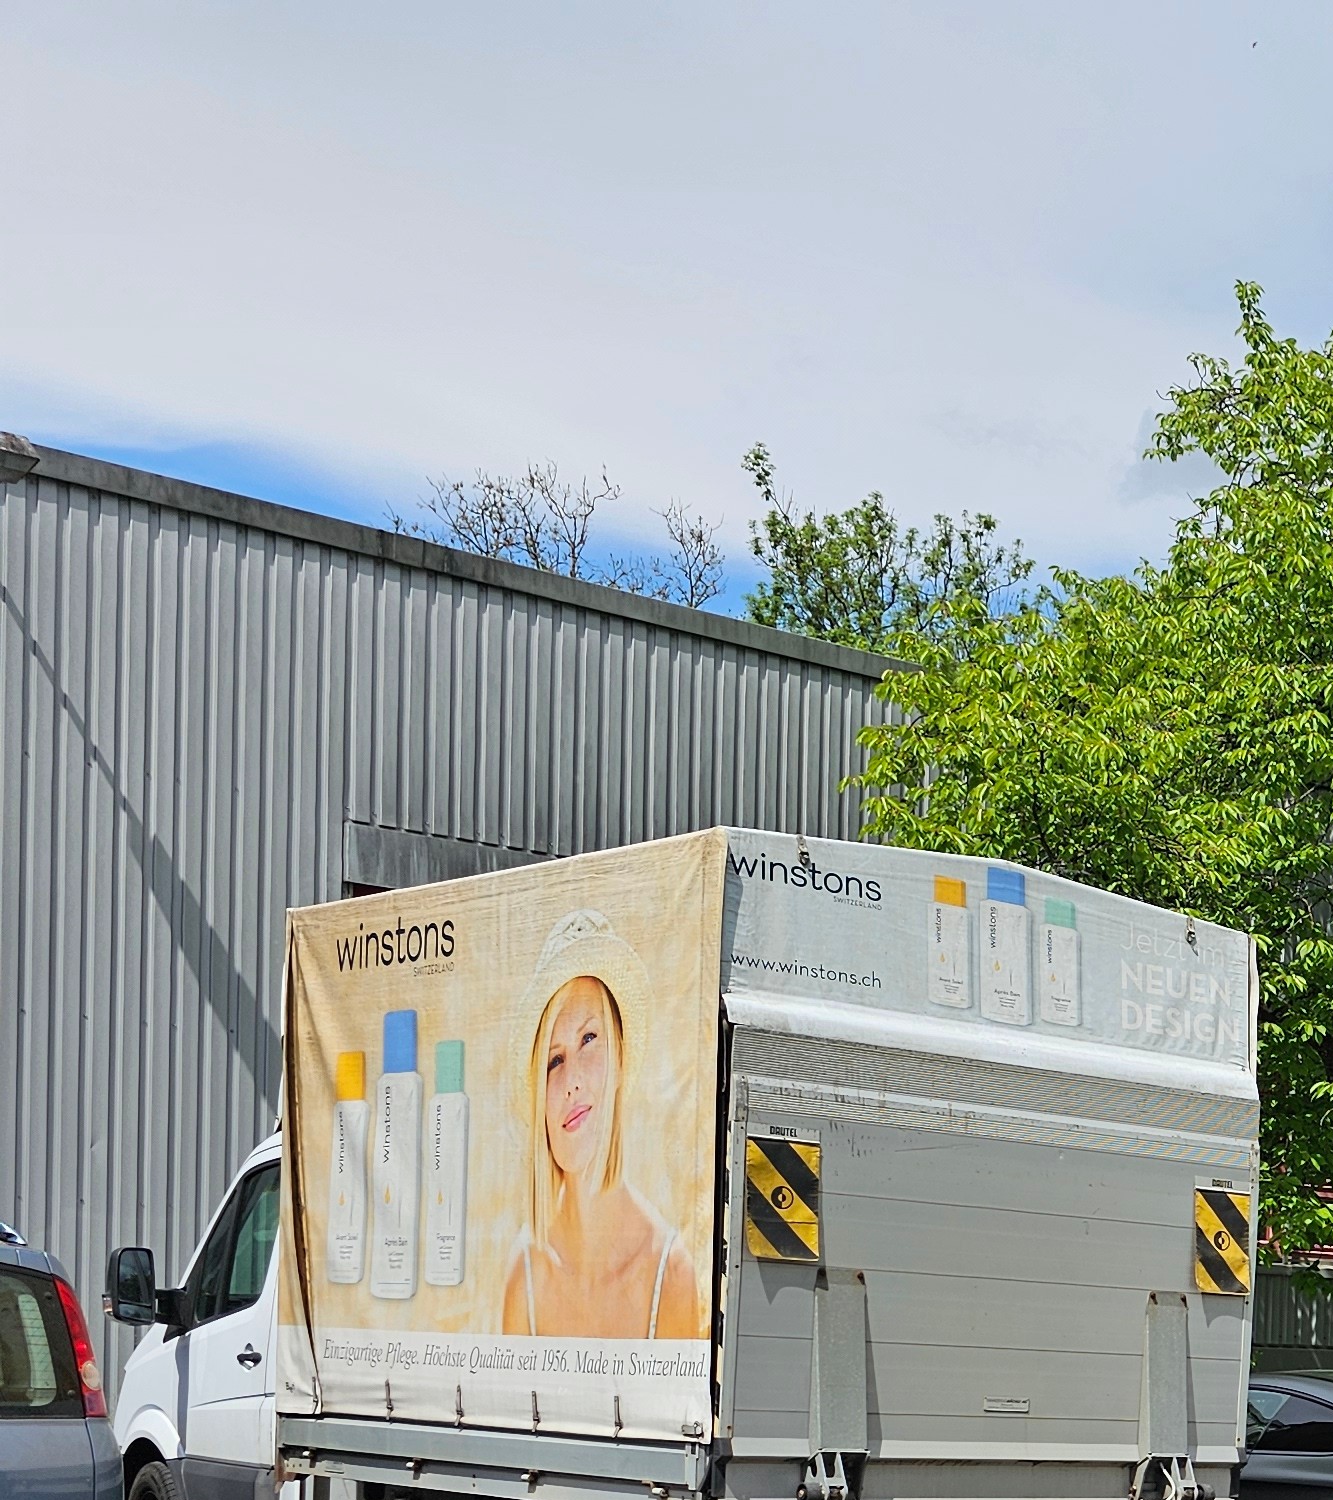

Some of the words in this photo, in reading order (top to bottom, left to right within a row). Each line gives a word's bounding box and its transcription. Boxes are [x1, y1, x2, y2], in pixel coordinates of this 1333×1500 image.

[730, 852, 882, 901] winstons
[833, 896, 883, 911] SWITZERLAND
[336, 916, 455, 972] winstons
[989, 906, 997, 949] winstons
[1120, 921, 1186, 961] Jetzt
[413, 962, 455, 977] SWITZERLAND
[730, 953, 882, 989] www.winstons.ch
[1120, 958, 1231, 1007] NEUEN
[1120, 998, 1239, 1047] DESIGN
[383, 1086, 391, 1163] winstons
[434, 1105, 442, 1171] winstons
[769, 1125, 797, 1138] DAUTEL
[323, 1338, 383, 1367] Einzigartige
[384, 1341, 419, 1370] Pflege.
[423, 1343, 466, 1368] Höchste
[469, 1346, 515, 1374] Qualität
[517, 1350, 537, 1372] seit
[541, 1349, 570, 1373] 1956.
[574, 1350, 609, 1375] Made
[612, 1353, 624, 1376] in
[628, 1351, 707, 1378] Switzerland.
